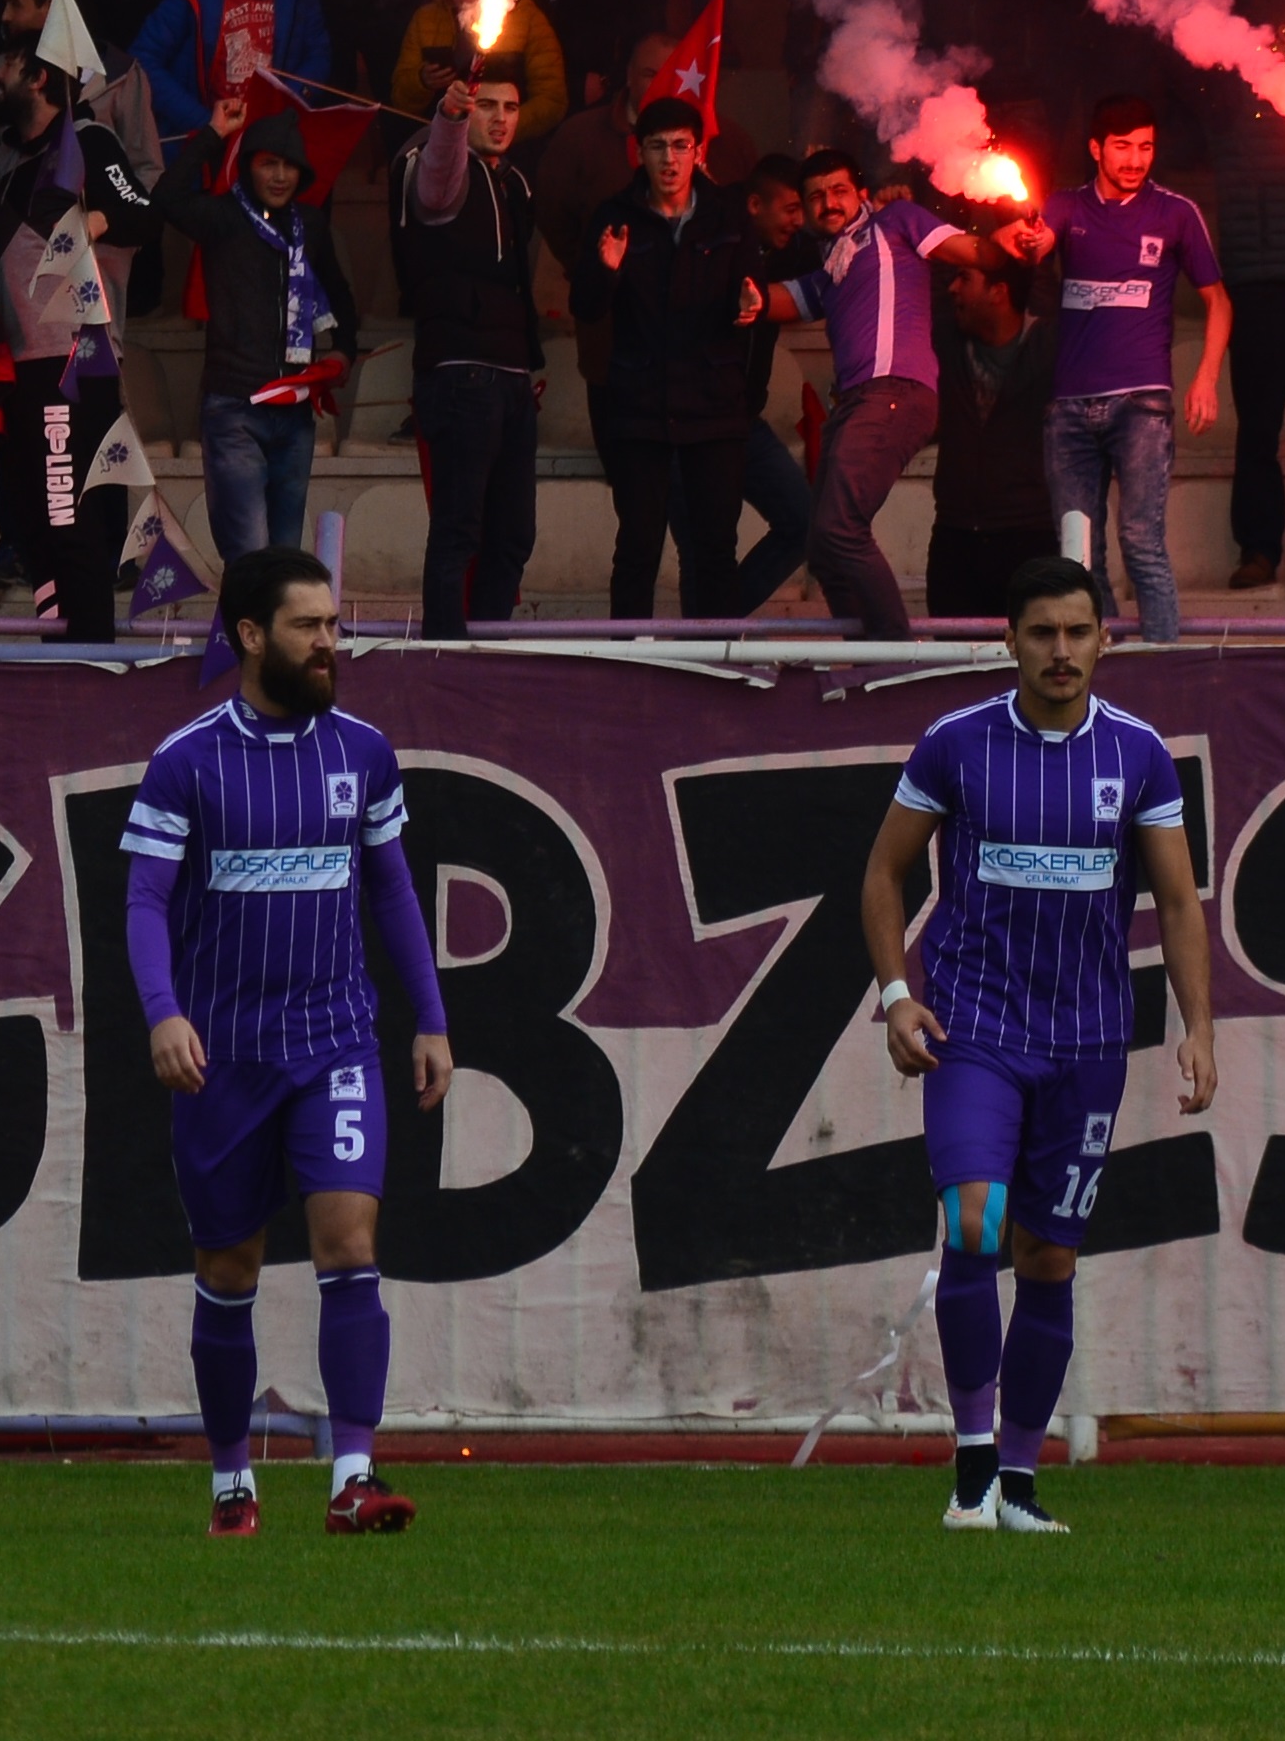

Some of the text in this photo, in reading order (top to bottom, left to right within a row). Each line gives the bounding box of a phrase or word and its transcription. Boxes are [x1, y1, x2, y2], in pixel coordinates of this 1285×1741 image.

[1052, 874, 1081, 885] HALAT
[333, 1109, 365, 1162] 5
[1051, 1164, 1104, 1220] 16
